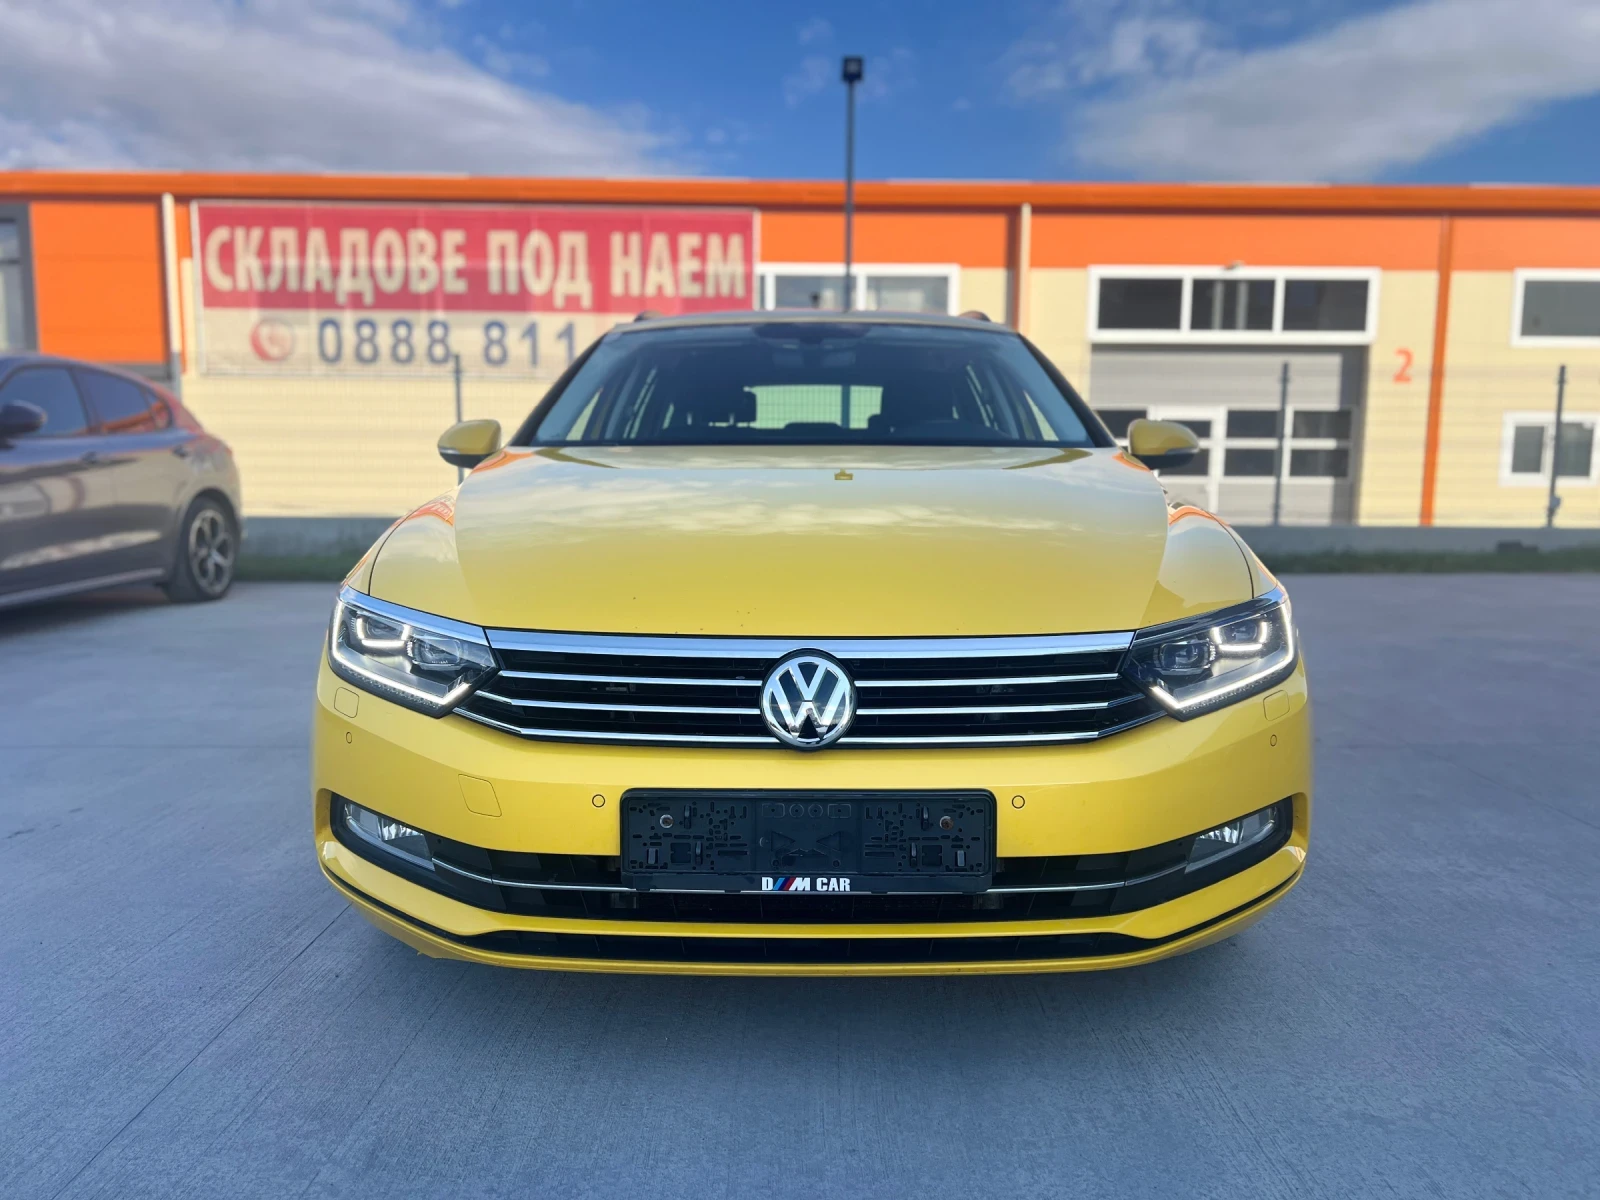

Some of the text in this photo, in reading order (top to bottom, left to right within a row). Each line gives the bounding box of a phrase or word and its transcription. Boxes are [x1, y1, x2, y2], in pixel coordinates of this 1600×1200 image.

[204, 226, 746, 309] СКЛАДОВЕ ПОД НАЕМ
[318, 318, 450, 364] 0888
[1392, 347, 1414, 384] 2
[816, 877, 851, 892] CAR
